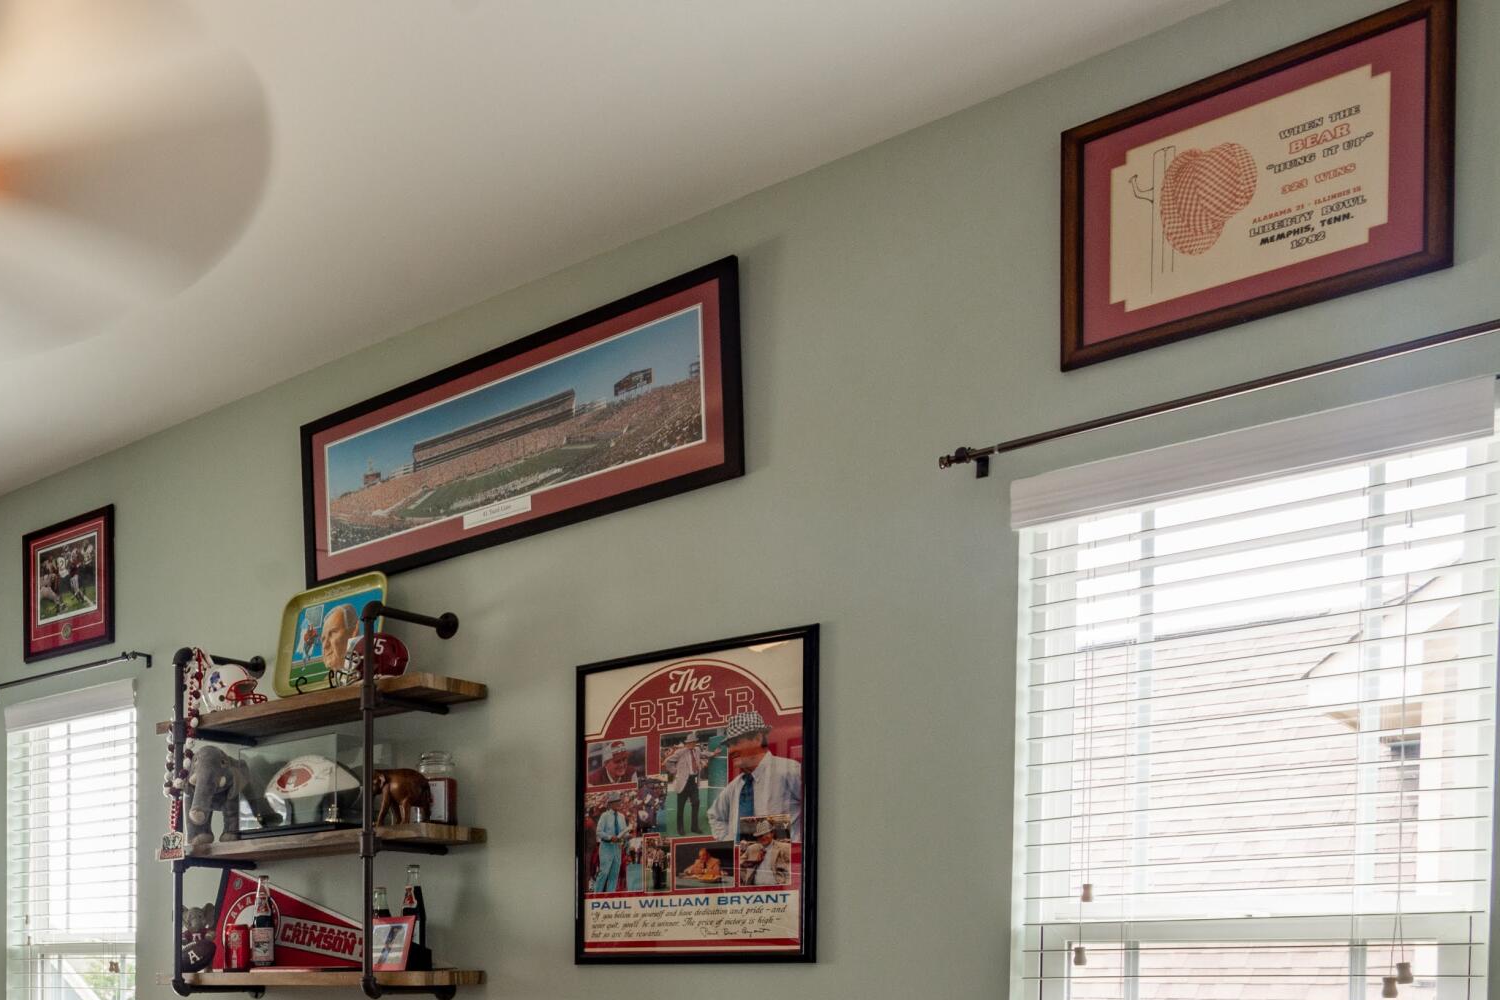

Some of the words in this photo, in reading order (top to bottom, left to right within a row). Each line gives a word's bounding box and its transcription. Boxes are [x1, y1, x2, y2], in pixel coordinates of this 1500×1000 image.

[1279, 117, 1324, 140] WHEN
[1328, 105, 1361, 123] THE
[1289, 123, 1351, 155] BEAR
[1322, 144, 1340, 158] IT
[1314, 162, 1357, 183] WINS
[1249, 210, 1314, 238] LIBERTY
[1321, 195, 1368, 216] BOWL
[1252, 207, 1292, 224] ALABAMA
[1314, 188, 1351, 206] ILLINOIS
[1259, 224, 1315, 246] MEMPHIS,
[1319, 212, 1354, 227] TENN.
[1290, 230, 1326, 250] 1982
[669, 669, 712, 694] The
[630, 686, 755, 735] BEAR
[591, 900, 632, 910] PAUL
[639, 896, 709, 908] WILLIAM
[717, 893, 790, 905] BRYANT
[665, 909, 678, 917] and
[694, 907, 728, 916] dedication
[729, 906, 743, 915] and
[771, 904, 788, 913] and
[281, 923, 357, 956] CRIMSON
[187, 950, 200, 965] A
